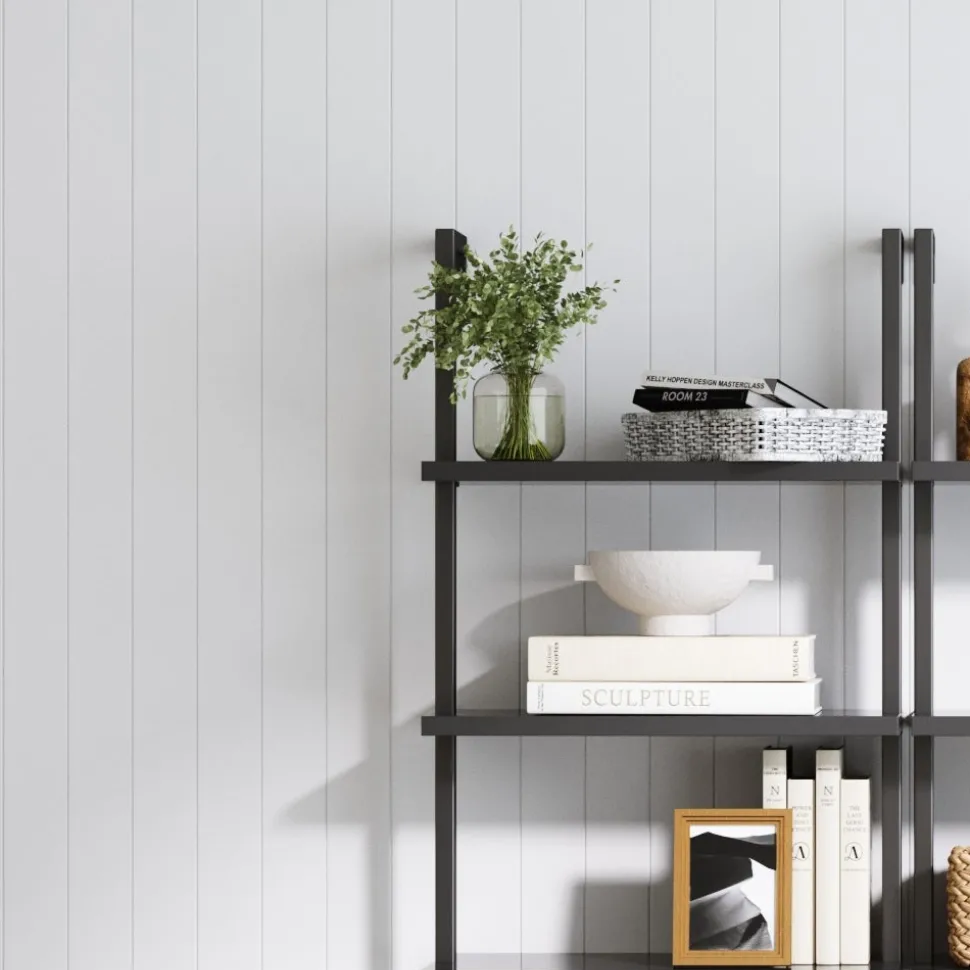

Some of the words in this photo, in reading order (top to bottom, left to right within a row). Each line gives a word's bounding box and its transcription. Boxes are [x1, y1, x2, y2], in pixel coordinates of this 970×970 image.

[646, 375, 666, 383] KELLY
[666, 376, 692, 384] HOPPEN
[693, 378, 718, 386] DESIGN
[718, 379, 765, 390] MASTERCLASS
[662, 391, 694, 401] ROOM
[695, 392, 708, 401] 23
[581, 688, 712, 707] SCULPTURE
